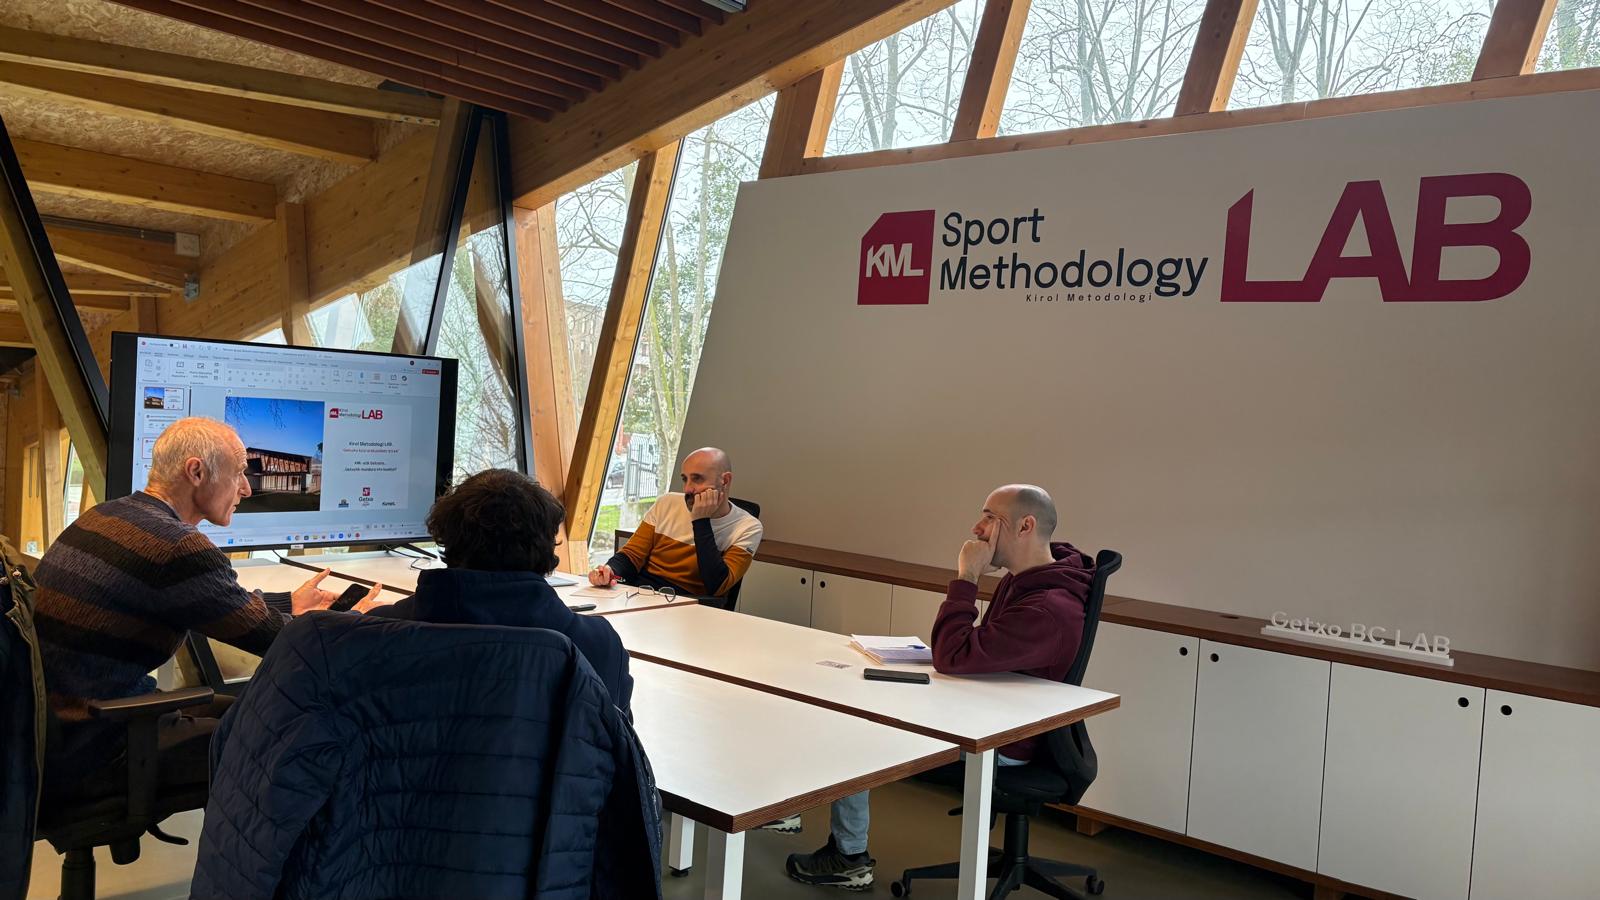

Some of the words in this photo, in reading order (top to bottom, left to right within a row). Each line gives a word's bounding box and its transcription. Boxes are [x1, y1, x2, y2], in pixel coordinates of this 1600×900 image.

[942, 208, 1045, 255] Sport
[1220, 172, 1532, 302] LAB
[865, 243, 924, 278] KML
[940, 248, 1209, 297] Methodology
[1026, 294, 1059, 302] Kirol
[1067, 293, 1152, 303] Metodologi
[362, 409, 383, 419] LAB
[1271, 611, 1342, 639] Getxo
[1351, 623, 1386, 647] BC
[1395, 629, 1450, 659] LAB
